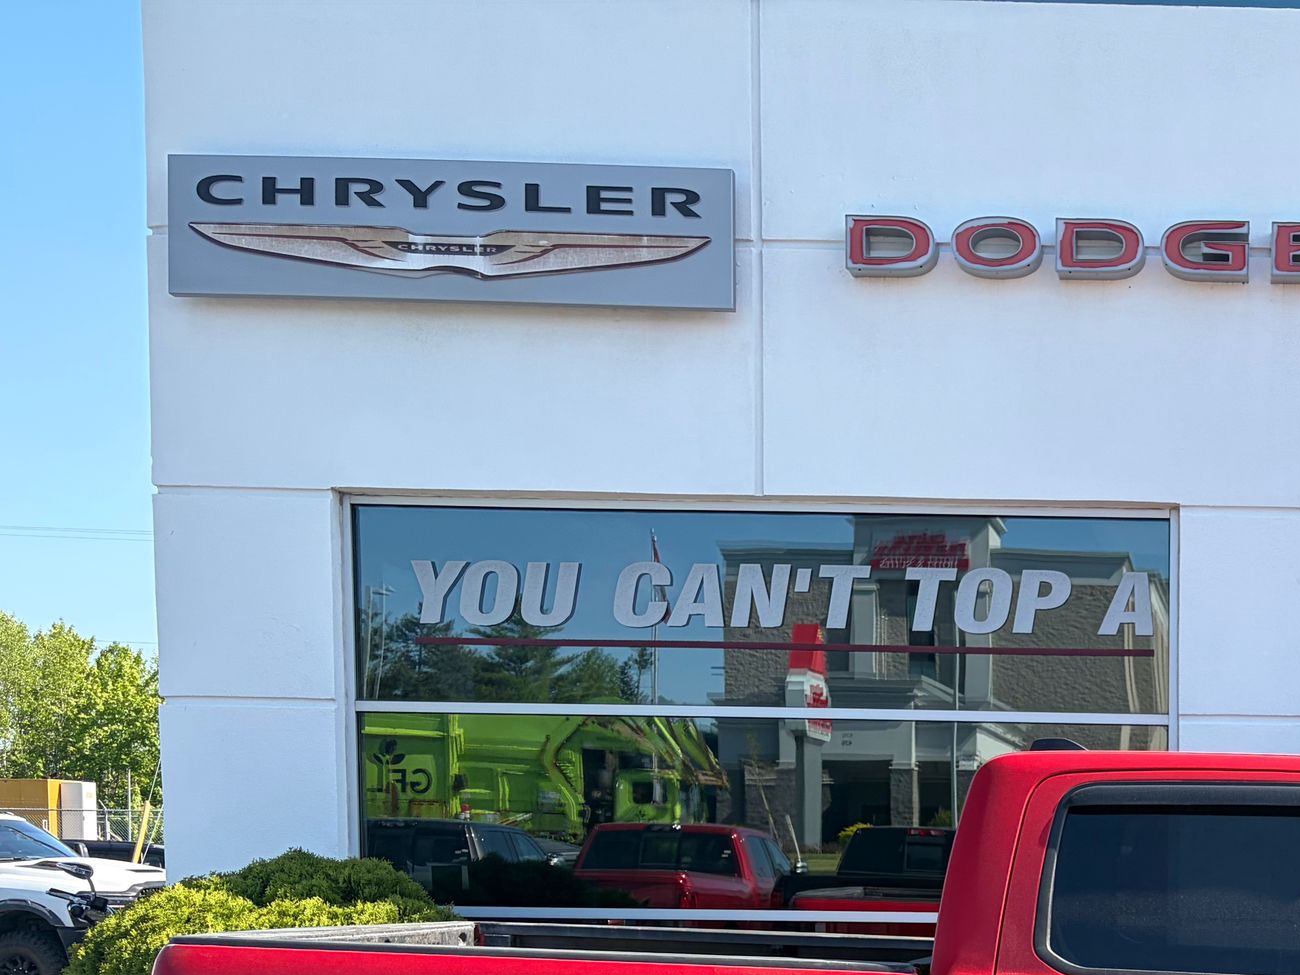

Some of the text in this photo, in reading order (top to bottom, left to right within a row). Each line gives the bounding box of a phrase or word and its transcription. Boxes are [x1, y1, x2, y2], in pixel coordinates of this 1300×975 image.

[196, 174, 704, 219] CHRYSLER
[398, 244, 497, 253] CHRYSLER
[411, 559, 1154, 637] YOU CAN'T TOP A
